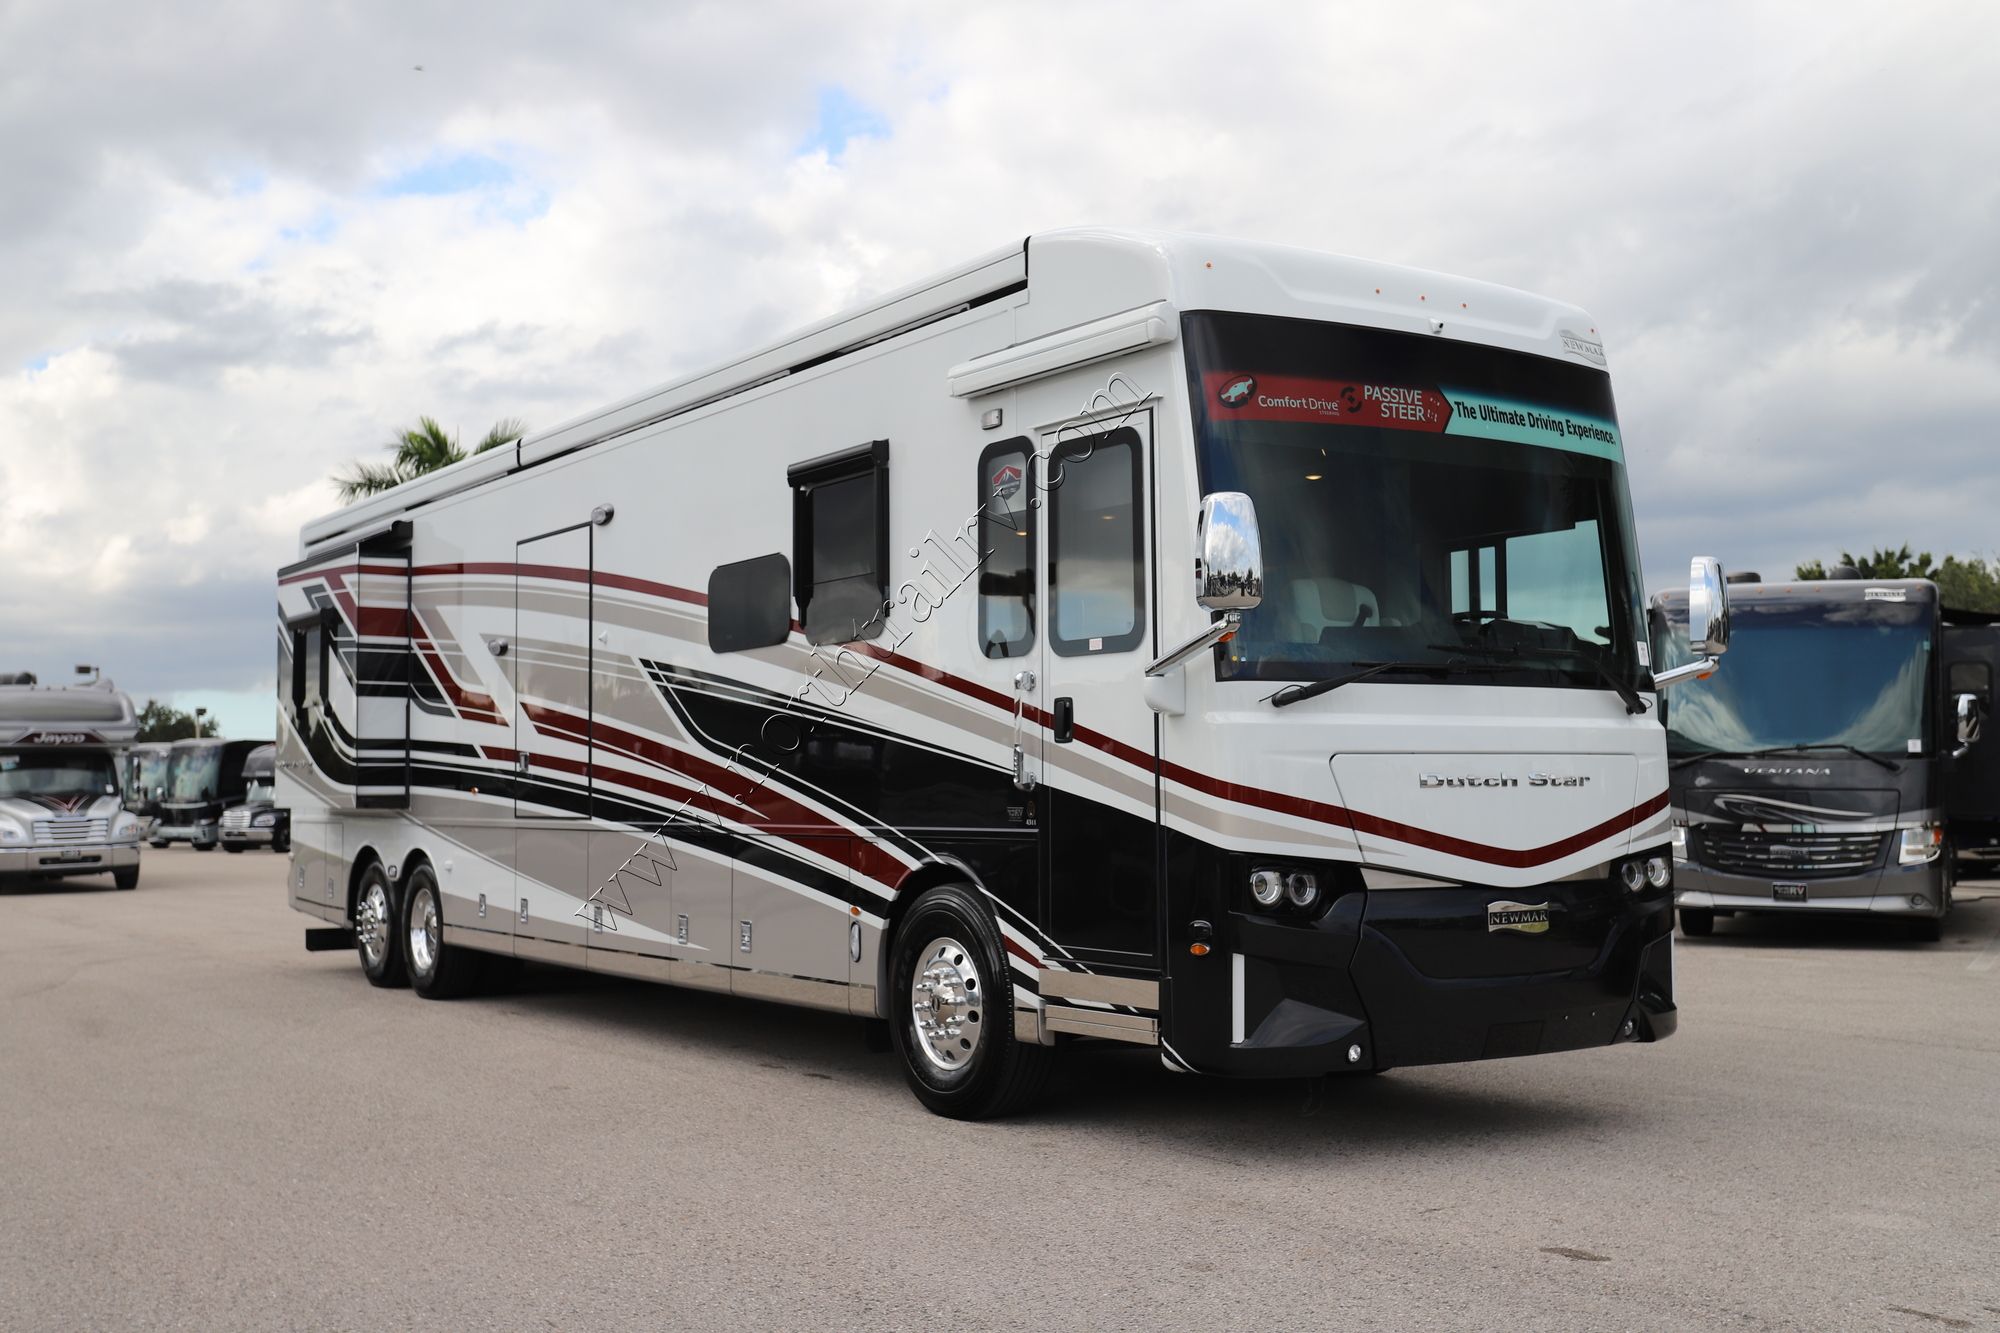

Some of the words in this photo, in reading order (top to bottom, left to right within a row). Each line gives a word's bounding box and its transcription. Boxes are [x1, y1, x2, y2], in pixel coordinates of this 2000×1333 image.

[1258, 395, 1307, 410] Comfort
[1364, 385, 1422, 405] PASSIVE
[1381, 403, 1426, 421] STEER
[1454, 400, 1477, 419] The
[1479, 404, 1526, 427] Ultimate
[1527, 412, 1565, 437] Driving
[33, 732, 86, 745] Jayco
[1419, 772, 1518, 788] Dutch
[1527, 771, 1590, 787] Star
[1490, 911, 1547, 924] NEWMAR
